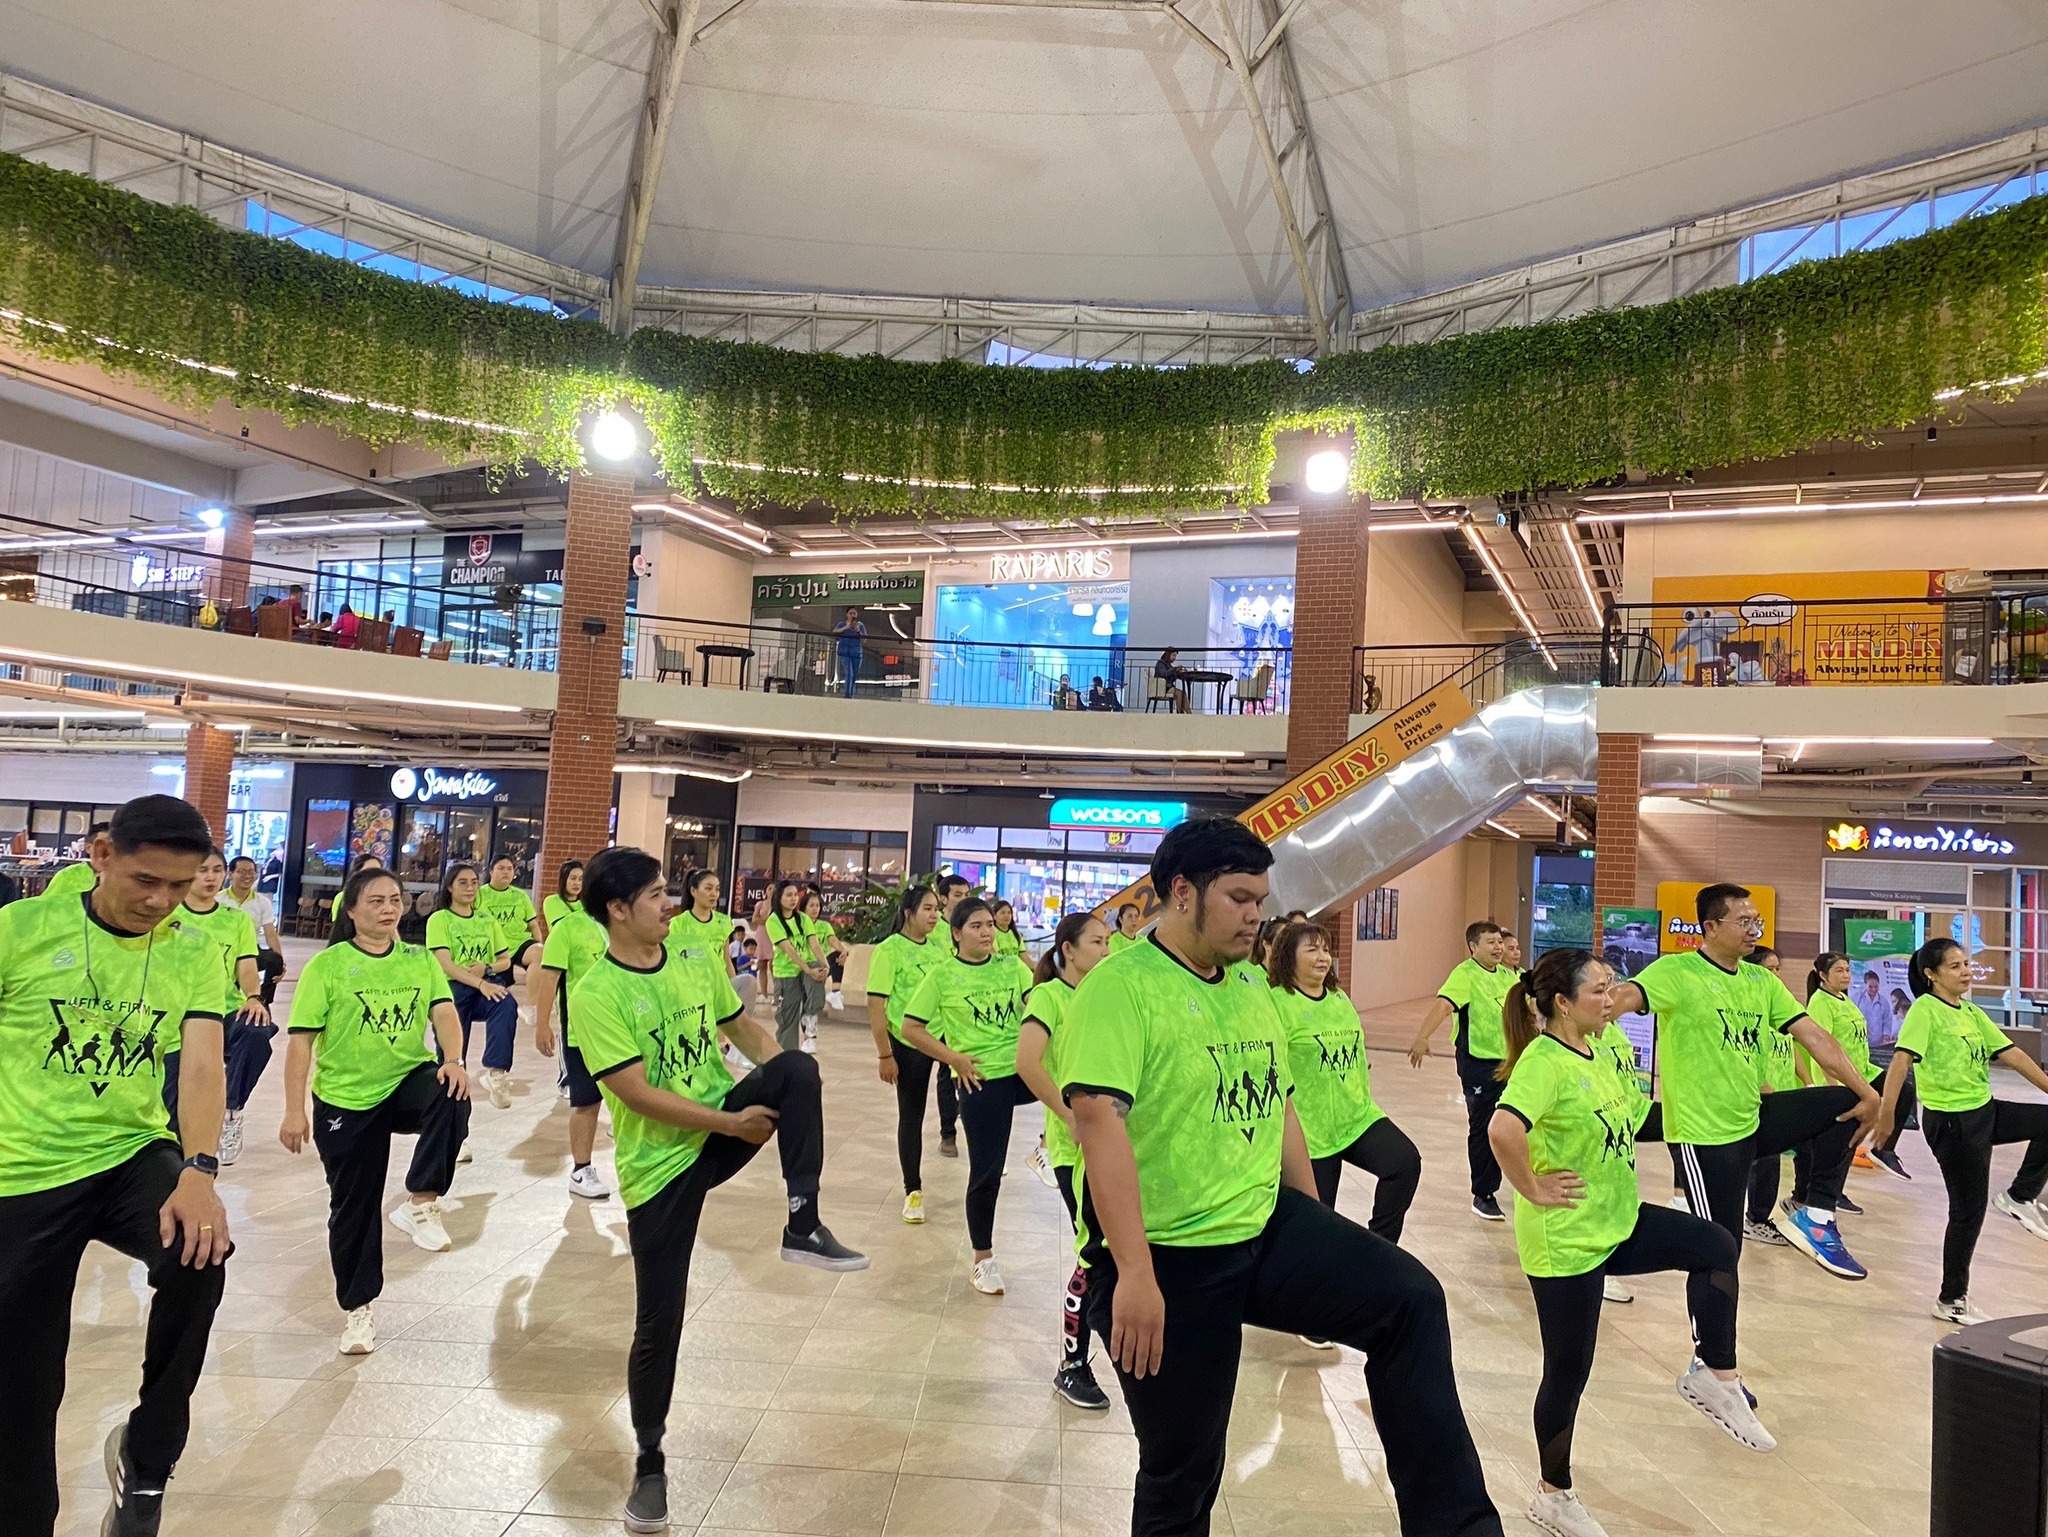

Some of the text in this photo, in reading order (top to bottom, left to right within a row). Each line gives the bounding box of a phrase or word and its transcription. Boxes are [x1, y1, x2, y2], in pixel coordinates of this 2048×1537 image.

[991, 550, 1112, 580] RAPARIS
[450, 566, 505, 584] CHAMPION
[545, 569, 564, 581] TA
[758, 578, 829, 603] ครัวปูน
[1834, 623, 1899, 638] Welcome to
[1815, 664, 1869, 675] Always
[1872, 664, 1900, 674] Low
[1393, 700, 1437, 733] Always
[1398, 721, 1424, 742] Low
[1403, 722, 1444, 751] Prices
[1070, 806, 1162, 824] watsons
[1873, 826, 2014, 855] นิตยาไก่ย่าง
[391, 986, 412, 995] FIRM
[103, 1000, 113, 1011] &
[119, 1001, 151, 1016] FIRM
[673, 1005, 697, 1021] FIRM
